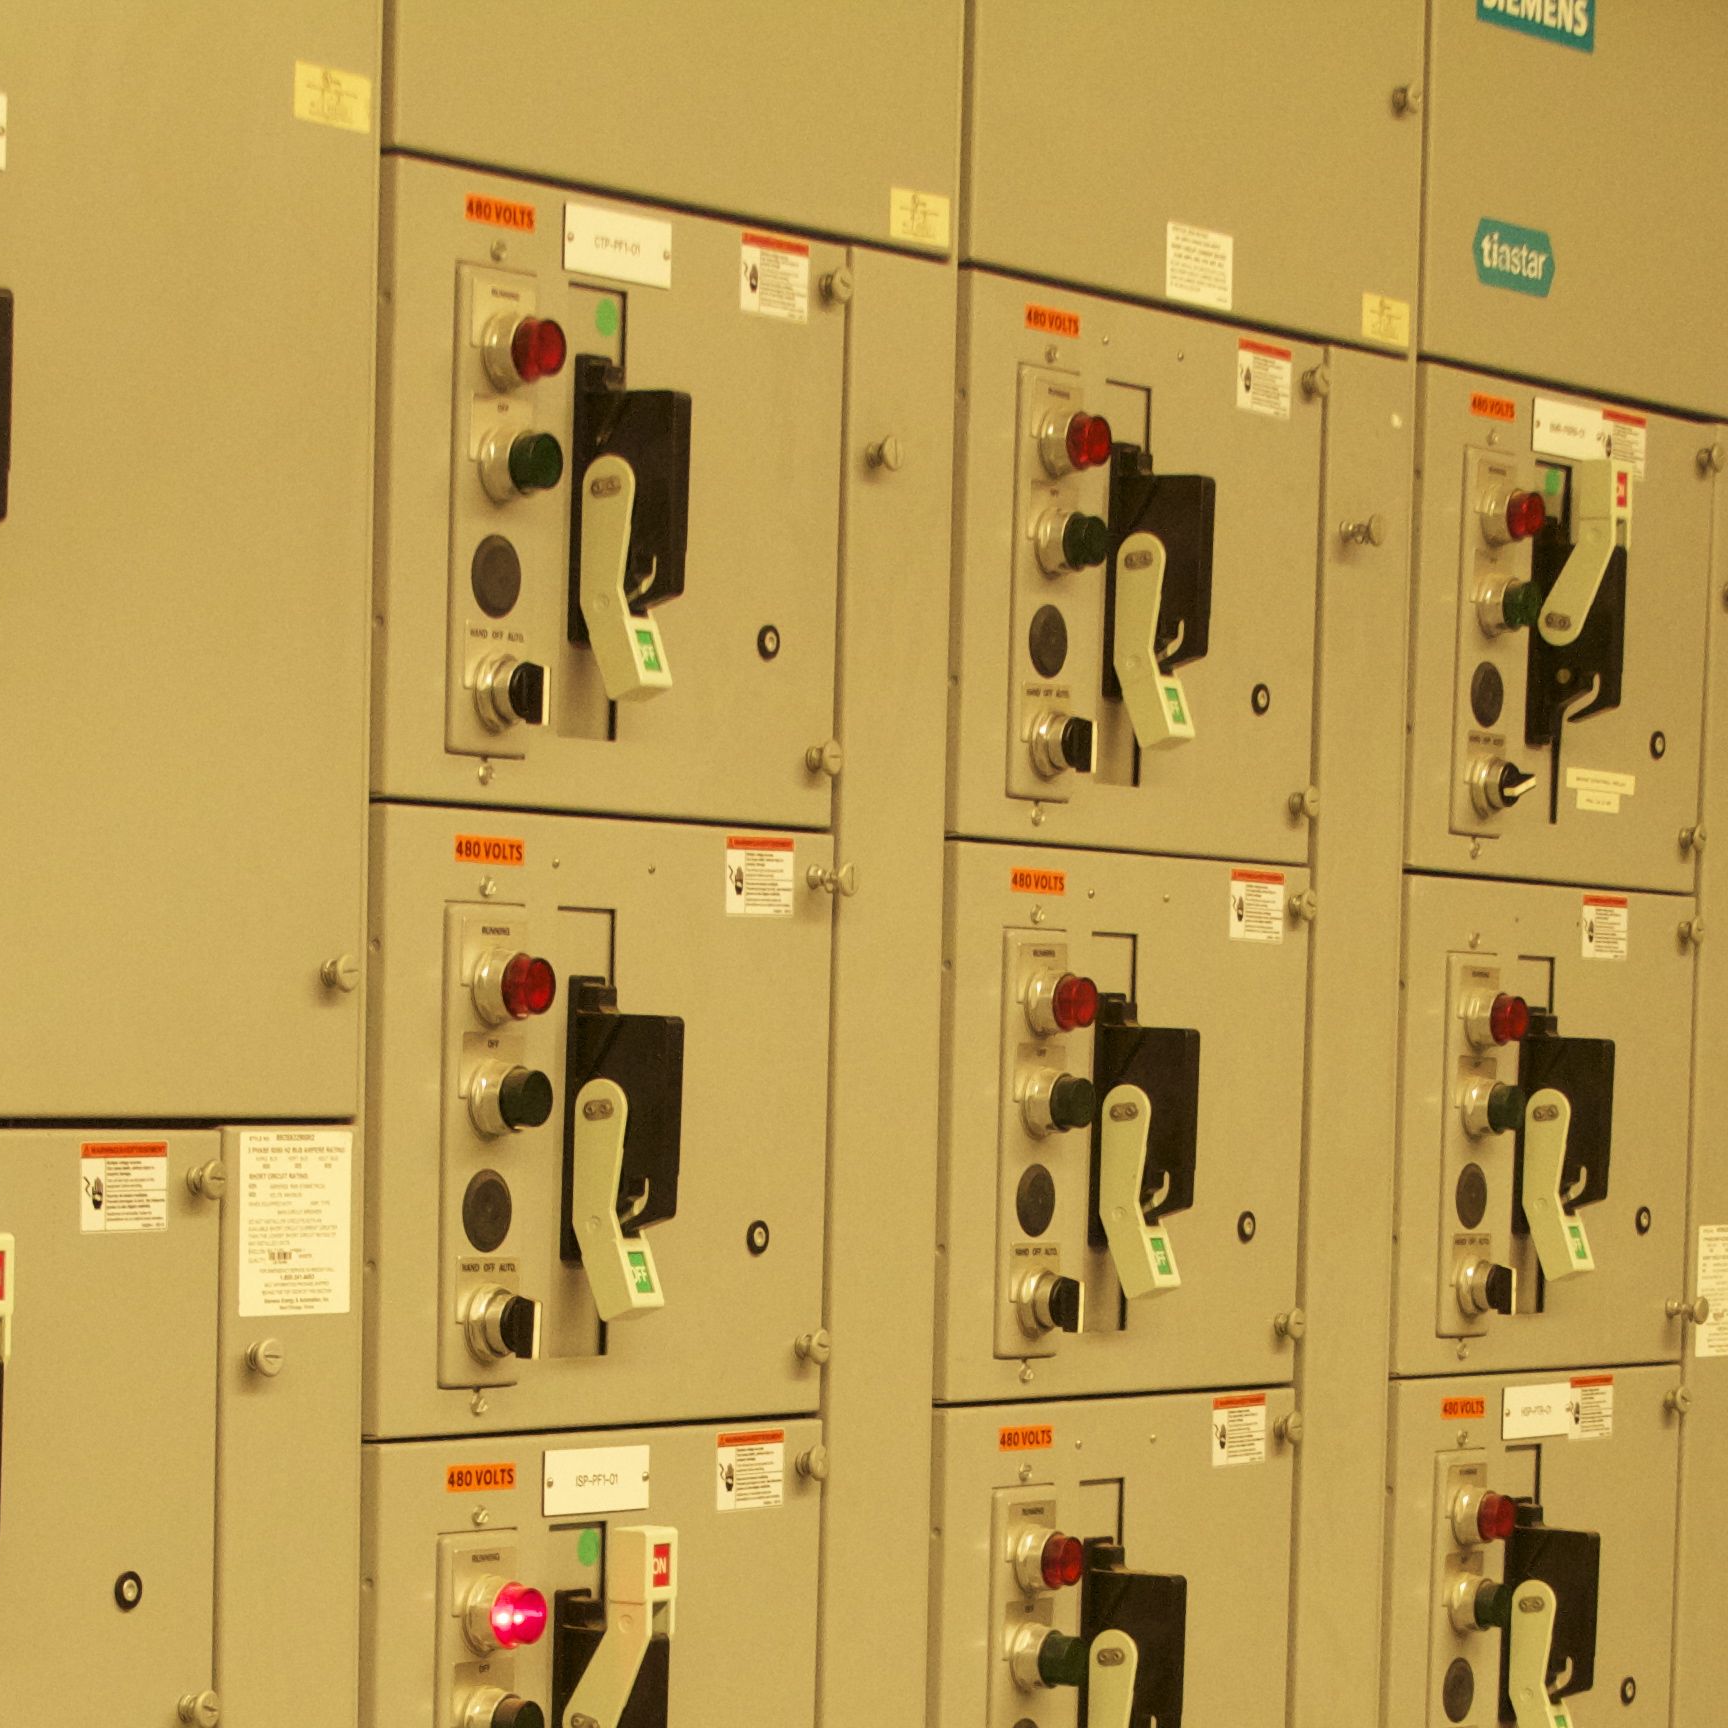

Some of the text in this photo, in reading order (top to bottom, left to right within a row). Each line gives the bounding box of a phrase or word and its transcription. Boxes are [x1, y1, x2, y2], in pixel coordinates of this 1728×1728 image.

[466, 198, 533, 227] 480 VOLTS
[1481, 233, 1546, 280] tiastar
[1026, 308, 1078, 333] 480 VOLTS
[456, 840, 522, 860] 480 VOLTS
[1012, 872, 1064, 890] 480 VOLTS
[1000, 1429, 1051, 1446] 480 VOLTS
[448, 1468, 513, 1487] 480 VOLTS
